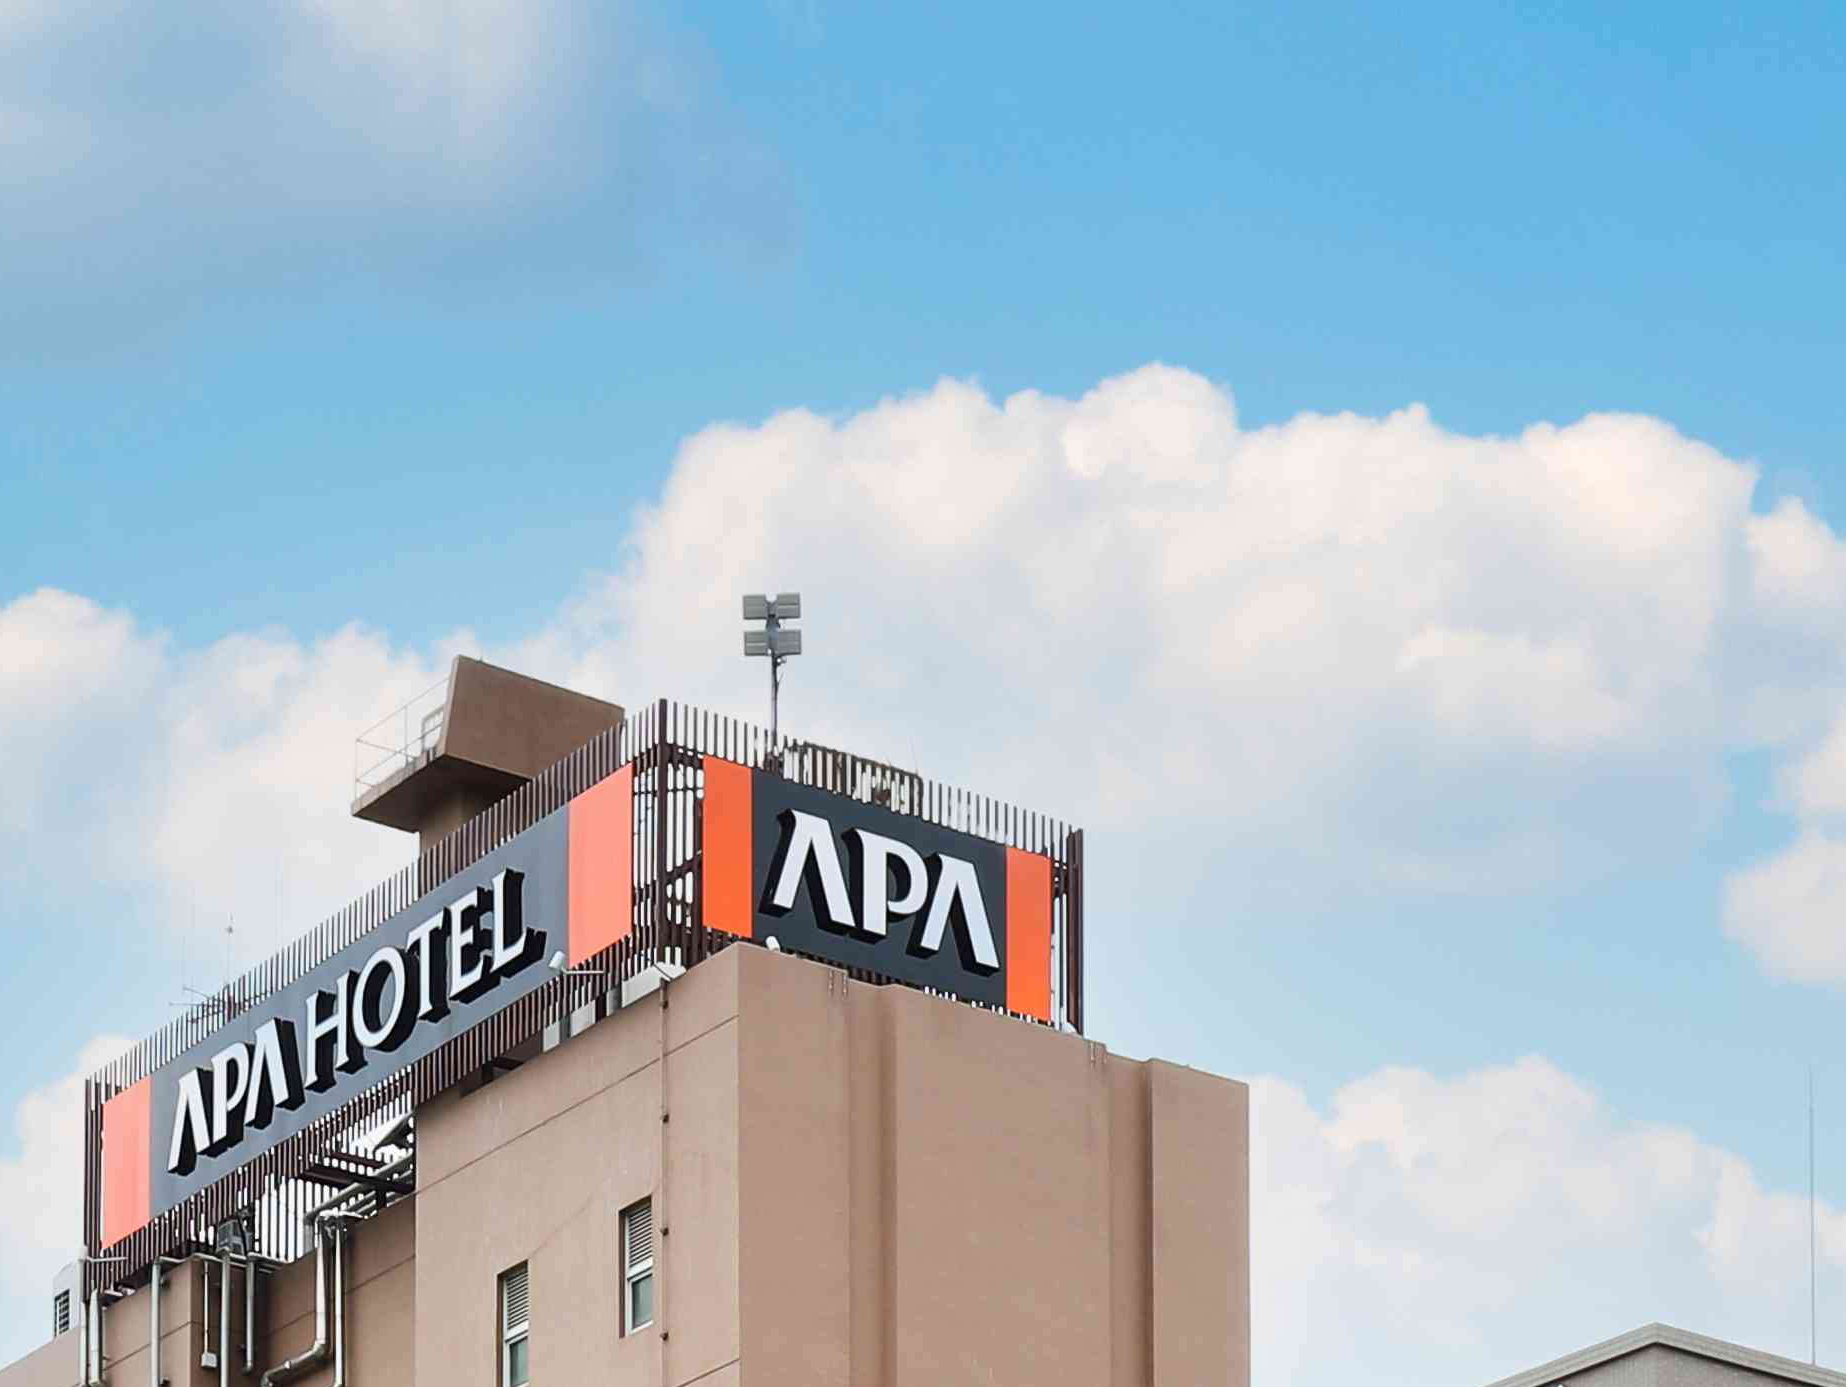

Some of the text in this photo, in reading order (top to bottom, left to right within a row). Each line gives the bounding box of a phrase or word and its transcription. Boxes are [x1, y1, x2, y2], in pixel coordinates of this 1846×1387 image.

[758, 808, 1000, 972] APA
[166, 867, 543, 1176] APA HOTEL
